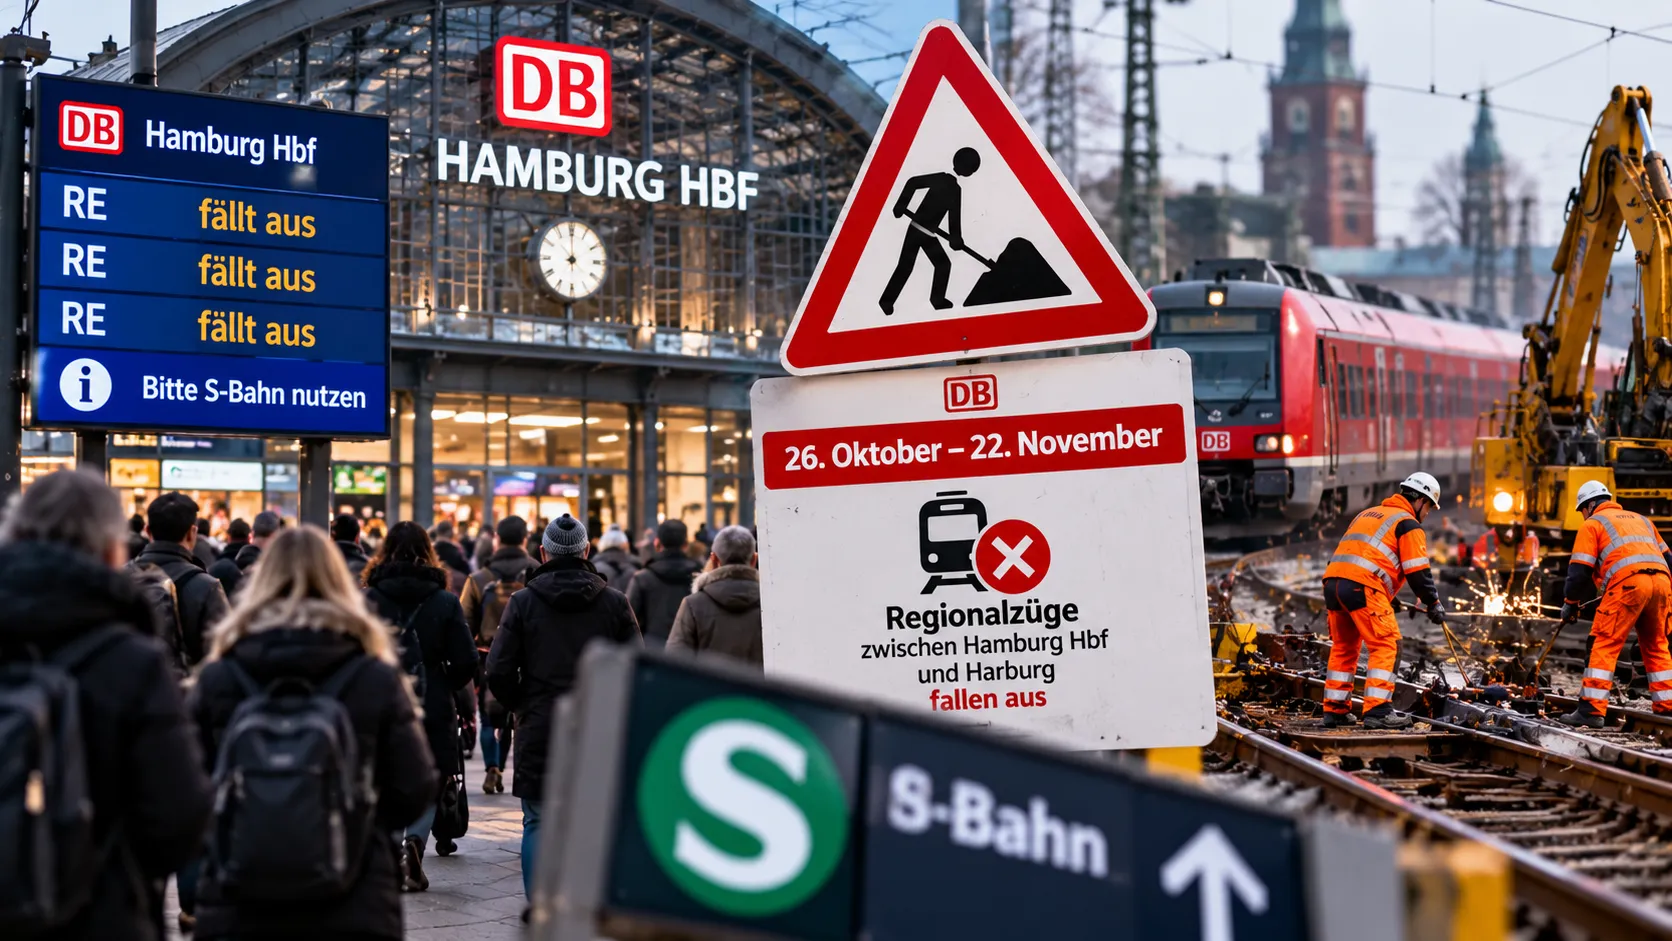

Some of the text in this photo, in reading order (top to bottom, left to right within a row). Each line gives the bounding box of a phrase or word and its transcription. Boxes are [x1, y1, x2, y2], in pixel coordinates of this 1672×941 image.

[510, 52, 599, 119] DB
[67, 110, 116, 145] DB
[146, 119, 318, 166] Hamburg Hbf
[436, 137, 760, 211] HAMBURG HBF
[62, 184, 108, 221] RE
[199, 197, 316, 239] fällt aus
[62, 242, 107, 279] RE
[198, 253, 316, 293] fällt aus
[62, 300, 106, 337] RE
[197, 309, 316, 348] fällt aus
[142, 375, 367, 409] Bitte S-Bahn nutzen
[949, 380, 992, 408] DB
[784, 444, 826, 472] 26.
[831, 438, 943, 469] Oktober
[970, 432, 1012, 460] 22.
[1017, 423, 1164, 457] November
[1203, 433, 1228, 449] DB
[885, 598, 1079, 636] Regionalzüge
[860, 629, 1109, 660] zwischen Hamburg Hbf
[917, 660, 1056, 685] und Harburg
[929, 688, 1048, 713] fallen aus
[674, 720, 812, 891] S
[887, 764, 1110, 879] S-Bahn
